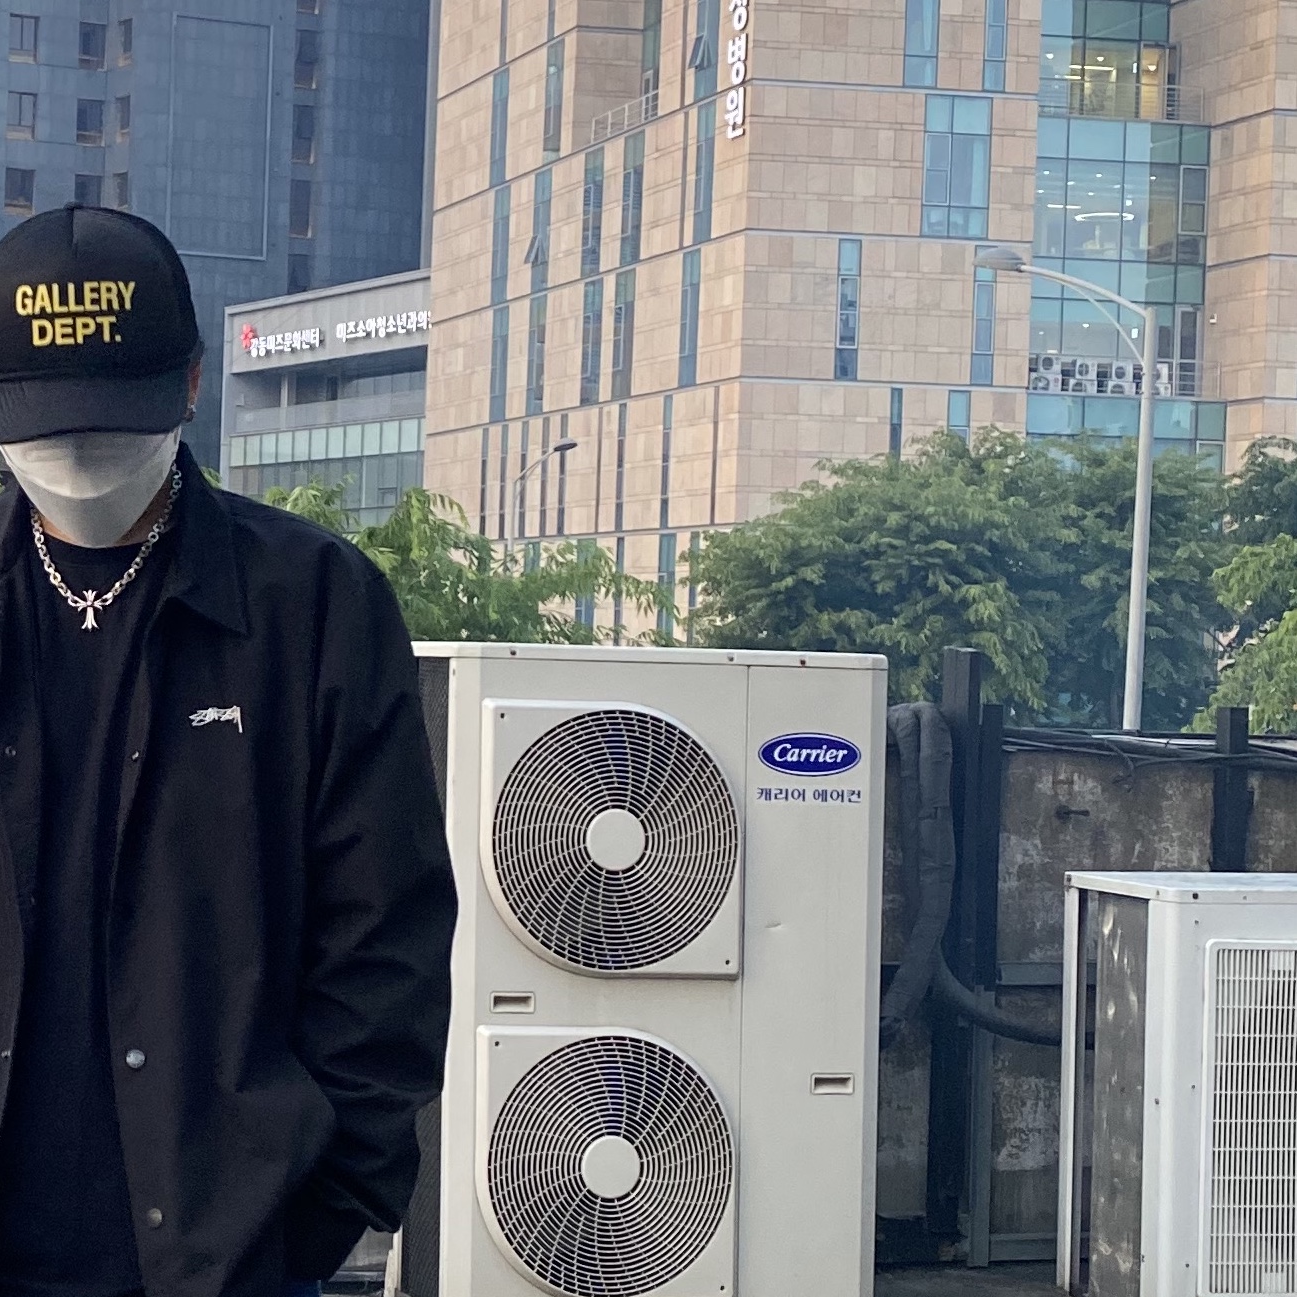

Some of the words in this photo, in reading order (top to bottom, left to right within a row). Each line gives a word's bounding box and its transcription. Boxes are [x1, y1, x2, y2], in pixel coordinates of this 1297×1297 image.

[15, 280, 136, 317] GALLERY
[31, 315, 122, 347] DEPT.
[336, 310, 432, 343] 미즈소아청소년과의
[249, 327, 320, 358] 강동미즈문화센터
[773, 743, 848, 763] Carrier
[756, 786, 806, 802] 캐리어
[812, 788, 861, 803] 에어컨
